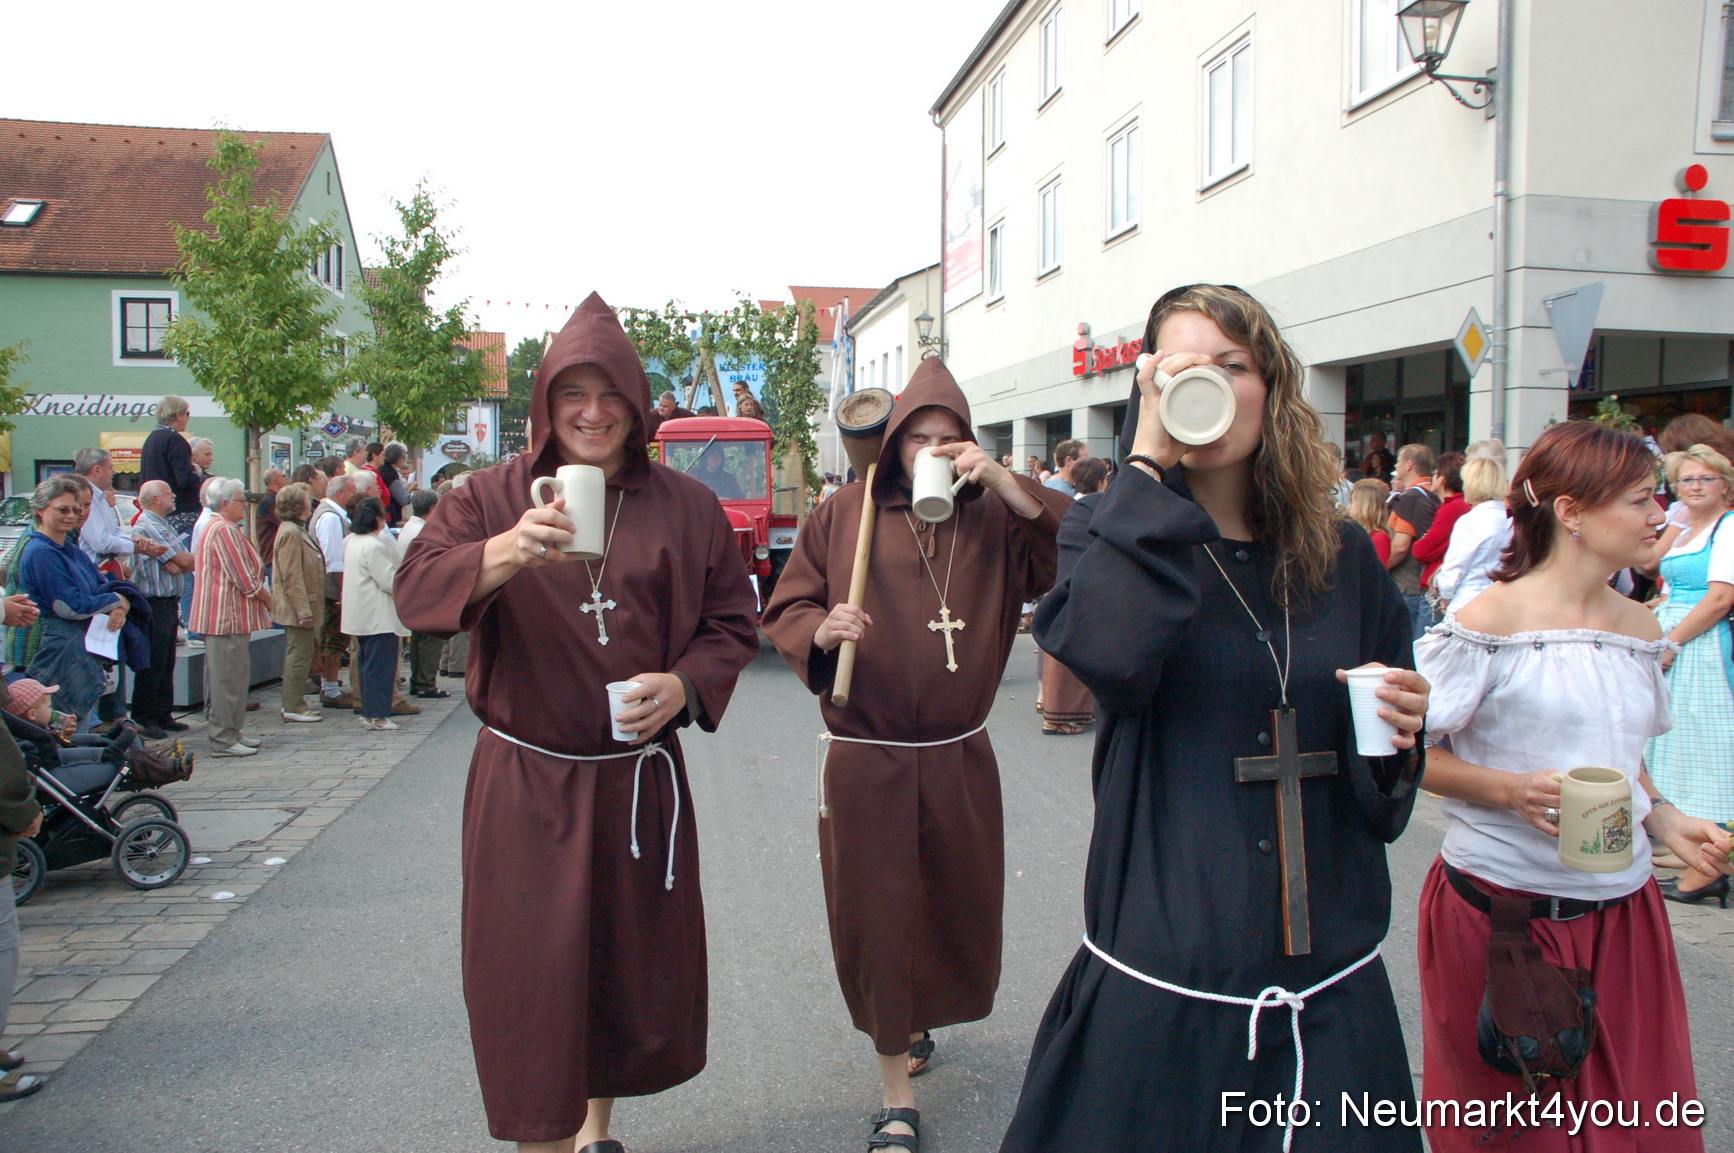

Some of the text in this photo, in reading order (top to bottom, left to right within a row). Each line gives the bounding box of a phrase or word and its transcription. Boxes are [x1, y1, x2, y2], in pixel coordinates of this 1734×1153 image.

[719, 362, 766, 372] KLSTER
[1092, 335, 1143, 378] Sparkass
[20, 392, 158, 423] Kneidinge
